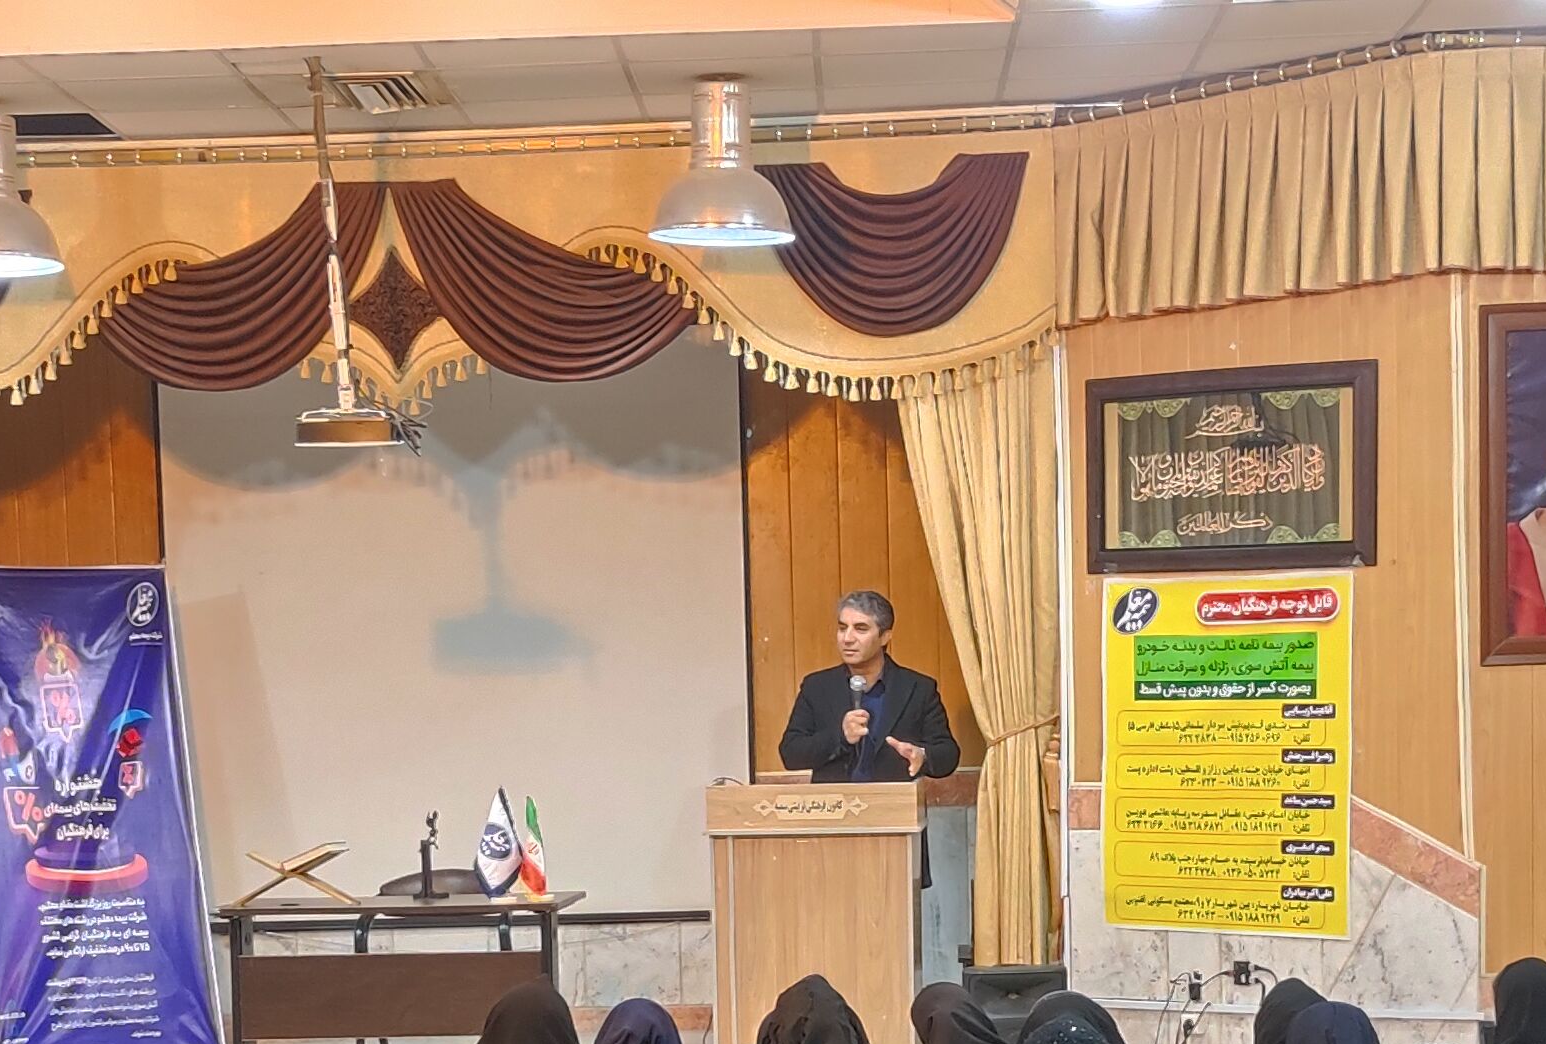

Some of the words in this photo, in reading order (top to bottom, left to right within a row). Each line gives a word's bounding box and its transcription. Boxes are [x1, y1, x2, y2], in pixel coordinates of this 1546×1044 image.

[1201, 600, 1231, 618] محترم
[1232, 595, 1279, 616] فرهنگیان
[1280, 594, 1309, 615] توجه
[1308, 593, 1333, 614] قابل
[1137, 640, 1170, 656] خودرو
[1172, 640, 1197, 654] بدنه
[1198, 643, 1205, 656] و
[1206, 638, 1236, 651] ثالث
[1239, 638, 1260, 650] نامه
[1262, 640, 1283, 653] بیمه
[1284, 640, 1315, 654] صدور
[1136, 660, 1166, 676] منازل
[1167, 660, 1199, 677] سرقت
[1199, 664, 1206, 676] و
[1208, 659, 1231, 676] زلزله
[1263, 656, 1289, 676] آتش
[1291, 661, 1314, 674] بیمه
[1139, 682, 1162, 694] قسط
[1163, 683, 1188, 698] پیش
[1188, 684, 1212, 697] بدون
[1211, 685, 1219, 698] و
[1219, 683, 1247, 698] حقوق
[1246, 681, 1256, 698] از
[1255, 680, 1278, 698] کسر
[1277, 683, 1312, 697] بصورت
[54, 774, 103, 798] جشنواره
[56, 819, 94, 841] فرهنگیان
[93, 823, 110, 840] برای
